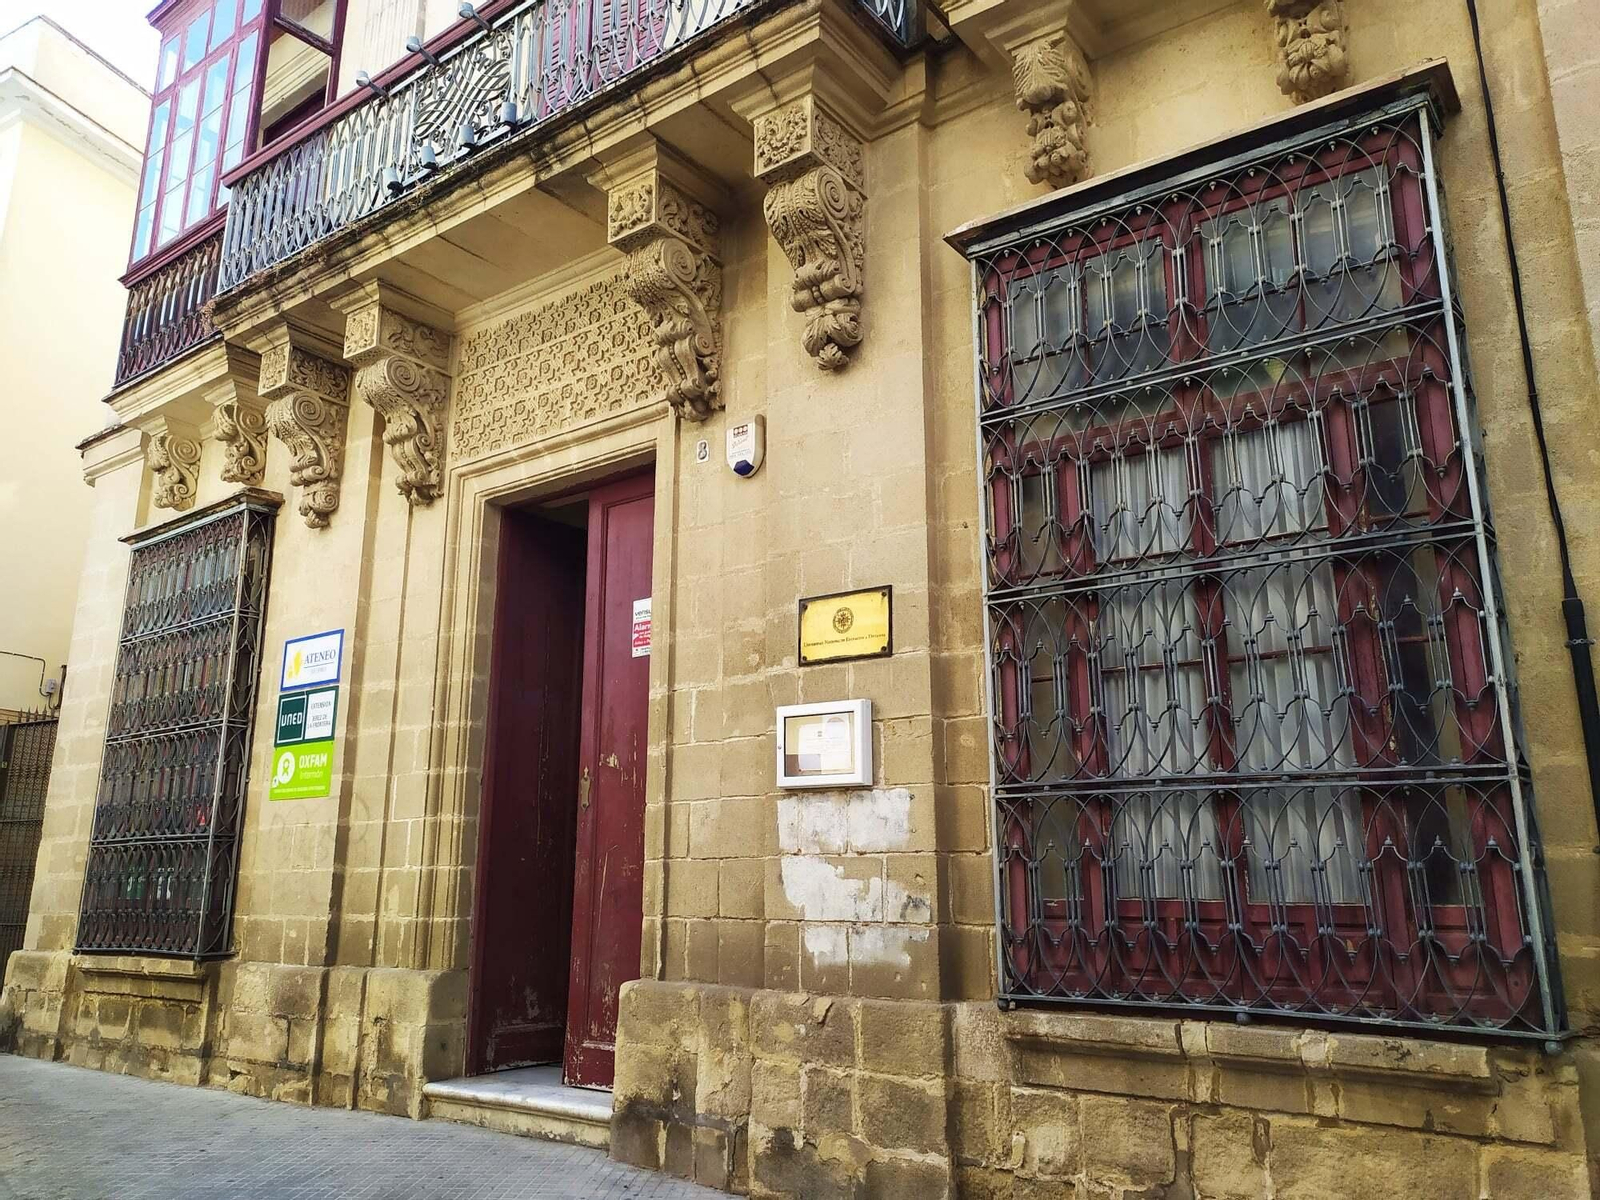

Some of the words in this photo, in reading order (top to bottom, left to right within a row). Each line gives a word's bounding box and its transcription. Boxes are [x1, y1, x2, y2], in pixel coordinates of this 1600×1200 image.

[698, 441, 708, 460] 8
[304, 649, 336, 664] ATENEO
[299, 753, 328, 769] OXFAM
